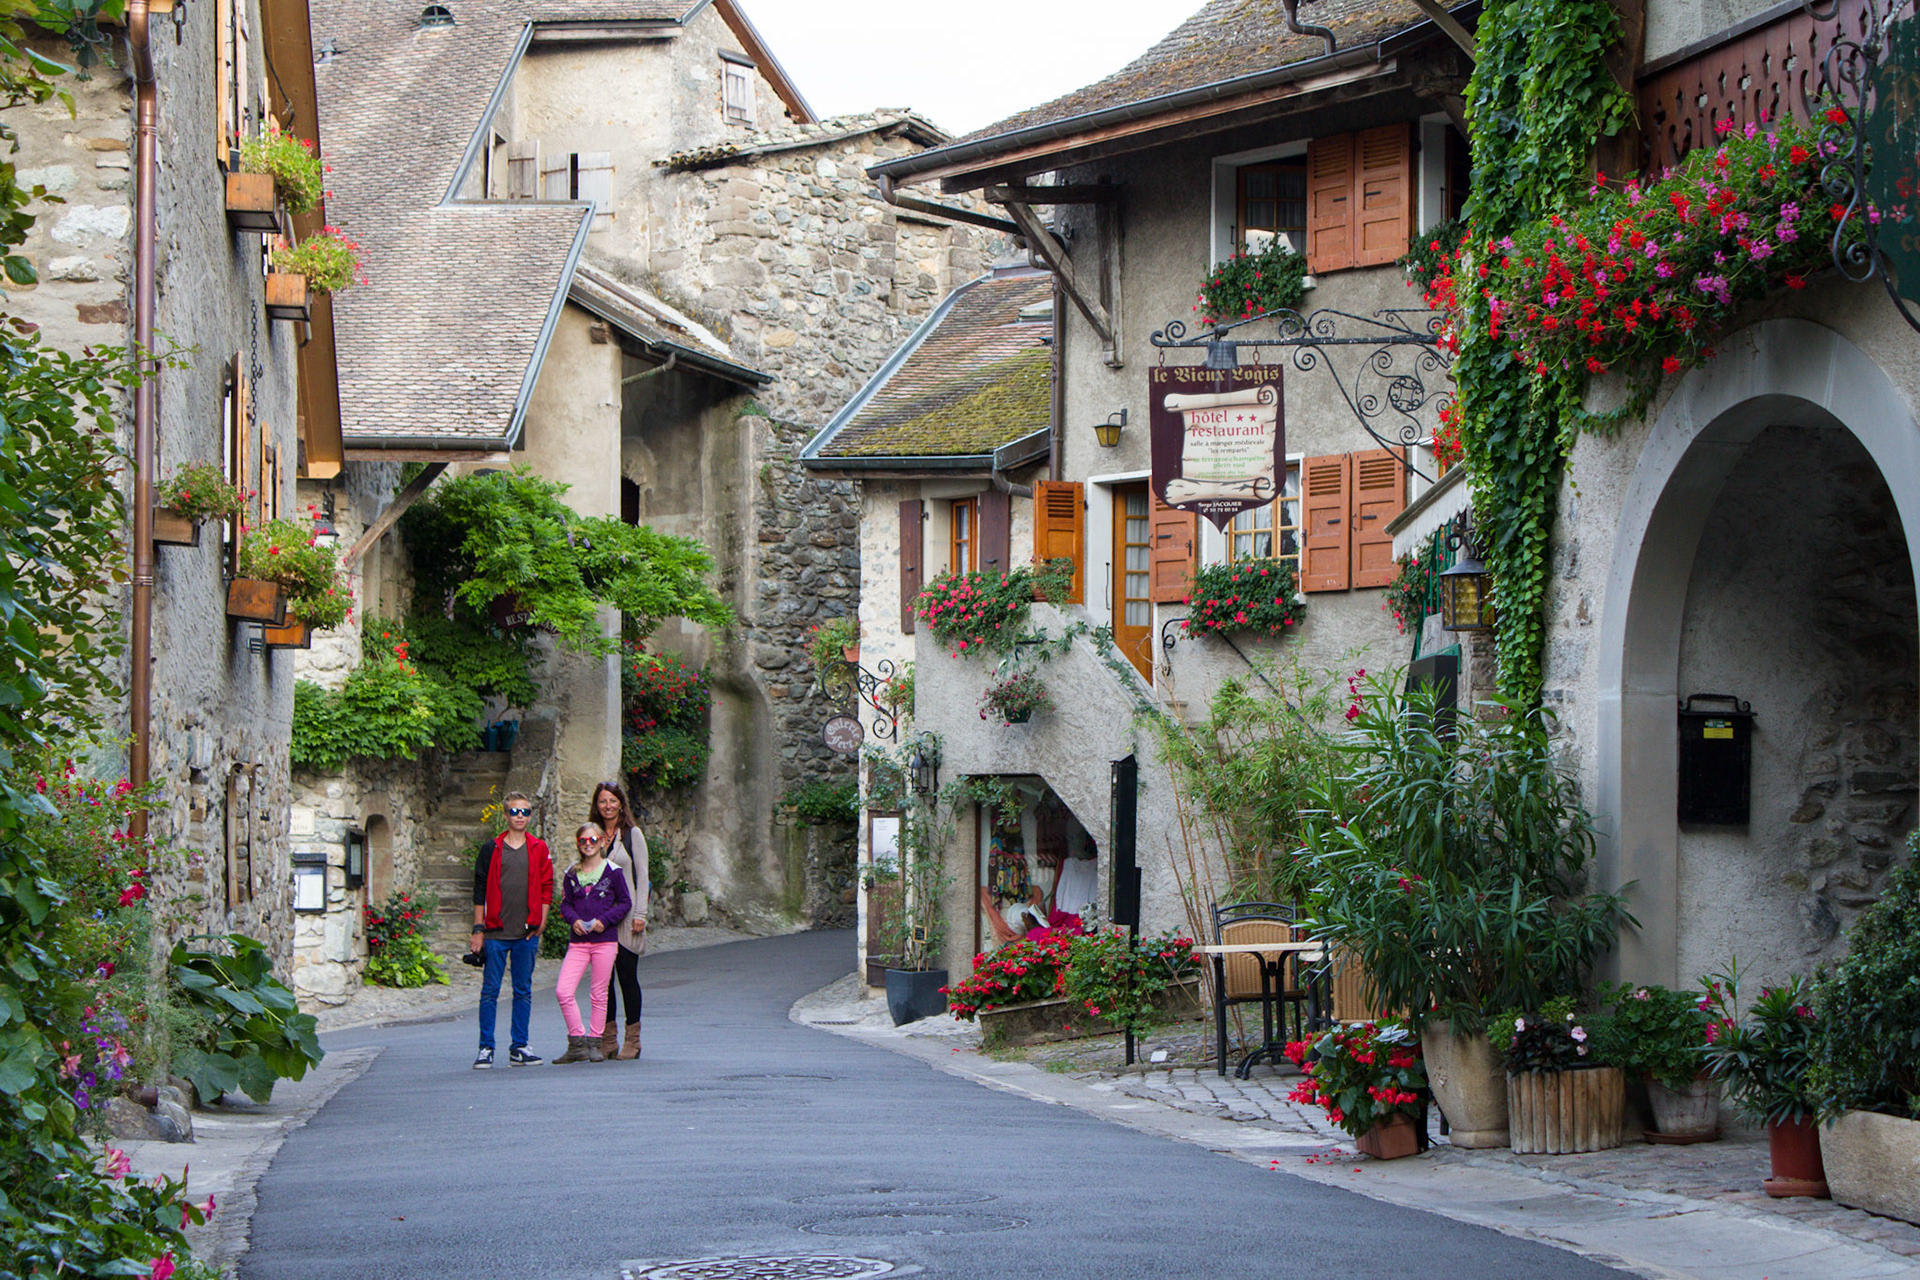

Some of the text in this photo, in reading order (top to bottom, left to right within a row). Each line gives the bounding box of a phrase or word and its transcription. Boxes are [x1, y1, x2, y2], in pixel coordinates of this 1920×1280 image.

[1154, 366, 1279, 384] le Vieux Logis
[1191, 409, 1228, 424] hôtel
[1192, 424, 1265, 437] restaurant
[826, 718, 860, 738] Galerie
